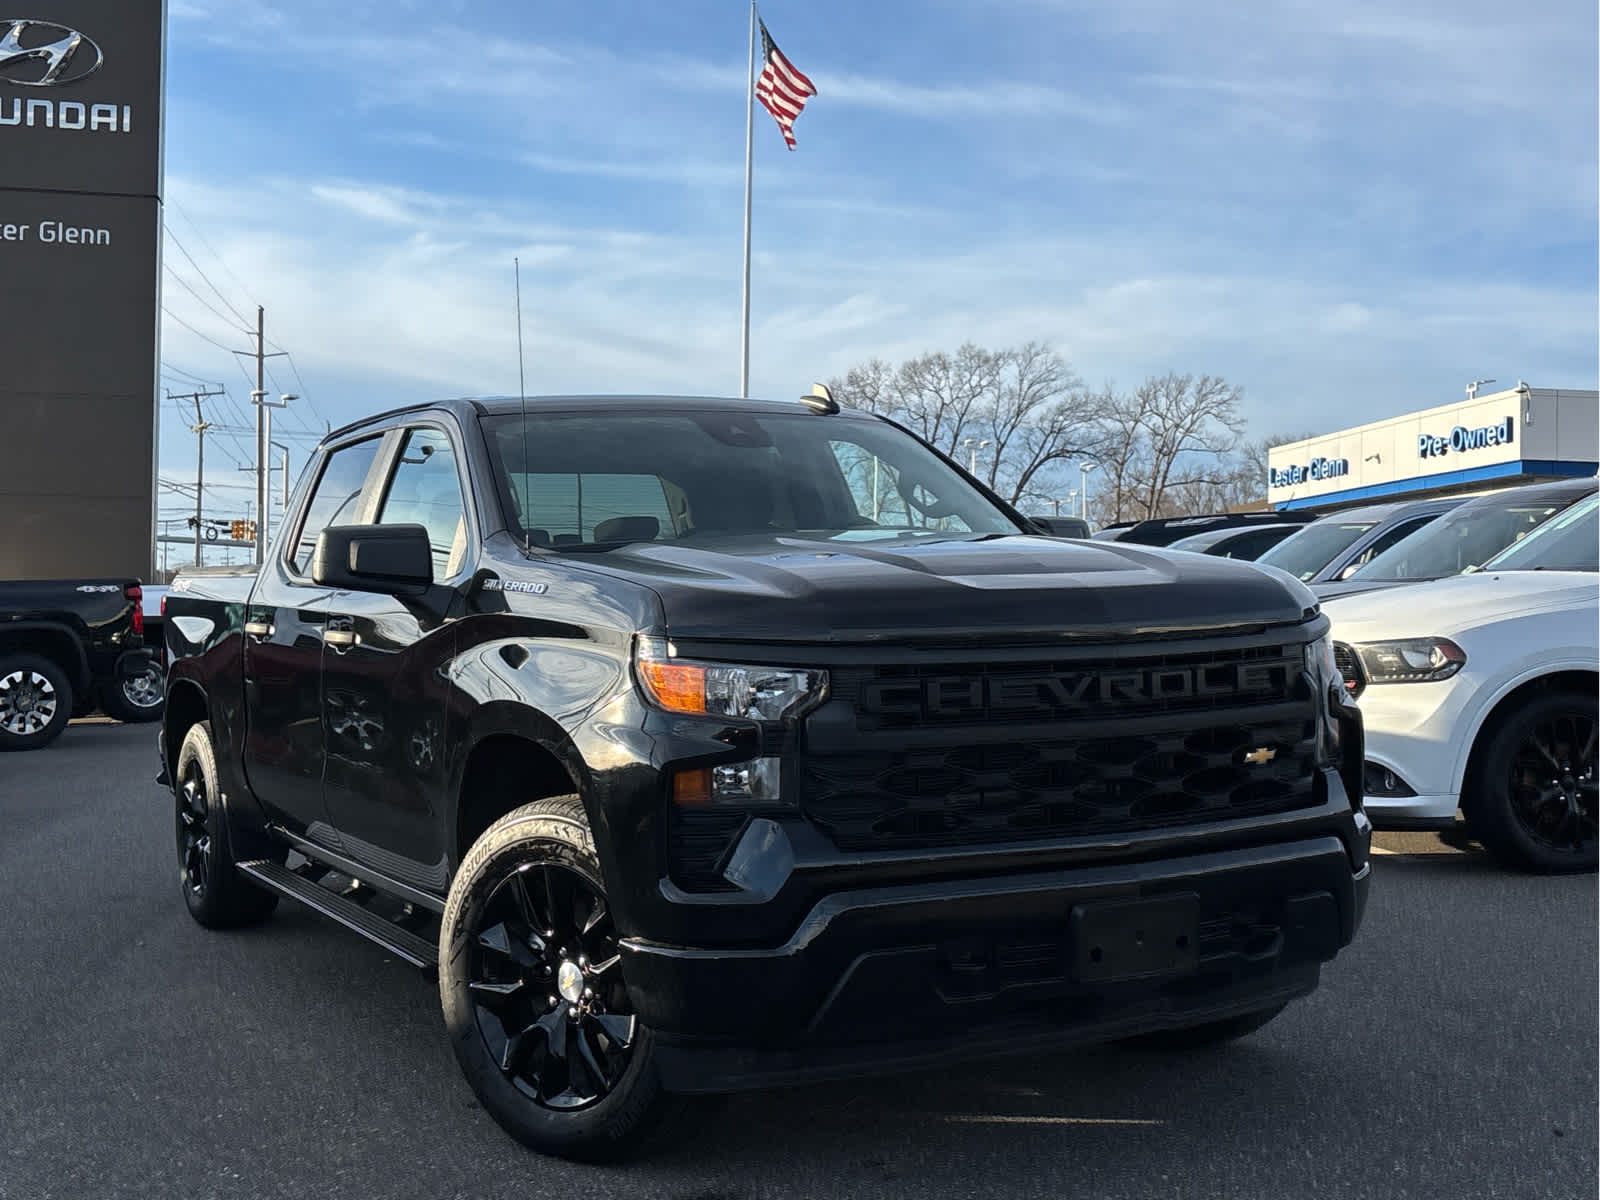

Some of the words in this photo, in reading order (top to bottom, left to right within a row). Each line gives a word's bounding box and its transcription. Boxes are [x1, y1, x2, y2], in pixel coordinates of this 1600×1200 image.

[39, 221, 111, 246] Glenn
[1418, 416, 1514, 459] Pre-Owned
[1269, 466, 1309, 488] Lester
[1311, 457, 1349, 481] Glenn
[863, 659, 1303, 714] CHEVROLET
